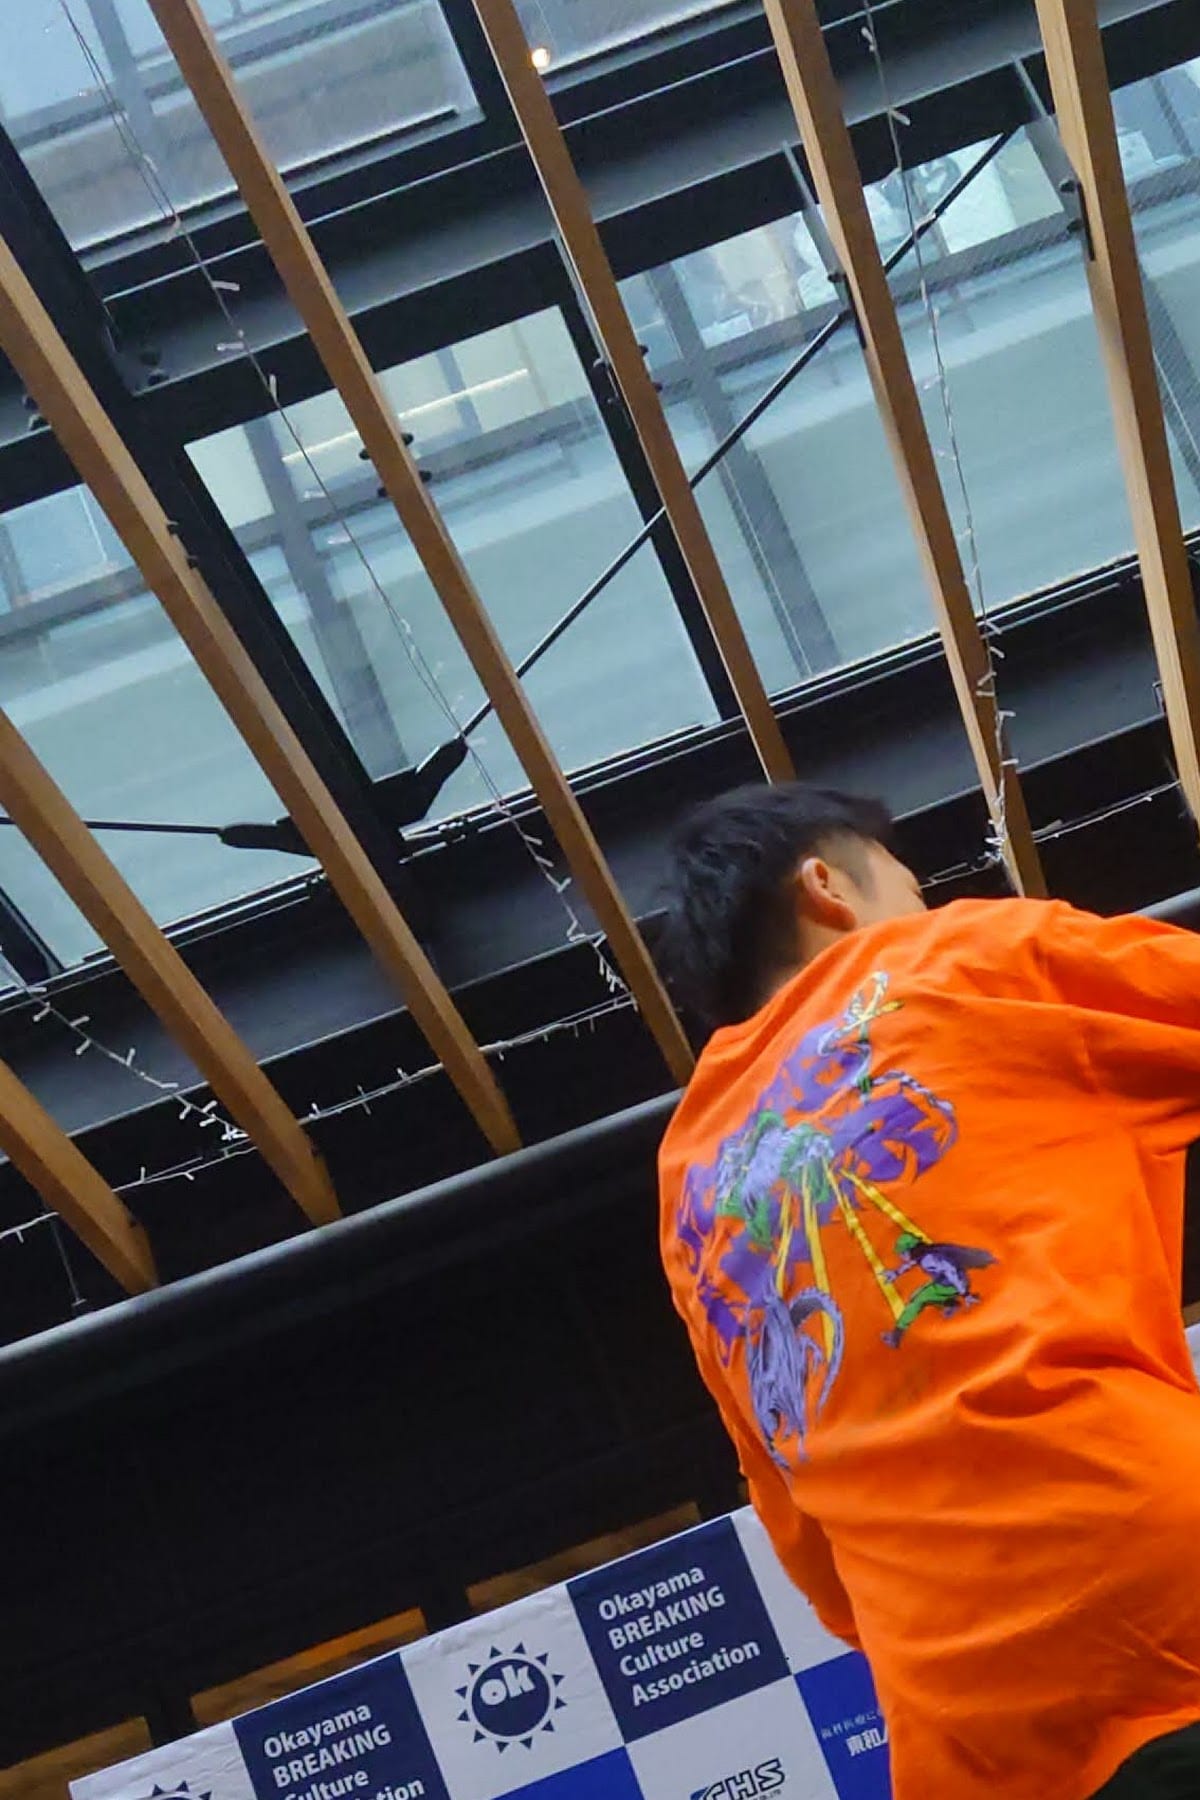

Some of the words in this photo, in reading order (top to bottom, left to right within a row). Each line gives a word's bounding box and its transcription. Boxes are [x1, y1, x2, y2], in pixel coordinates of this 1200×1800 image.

[599, 1567, 705, 1620] Okayama
[608, 1586, 726, 1650] BREAKING
[619, 1631, 704, 1676] Culture
[632, 1641, 761, 1707] Association
[264, 1704, 372, 1758] Okayama
[273, 1724, 391, 1788] BREAKING
